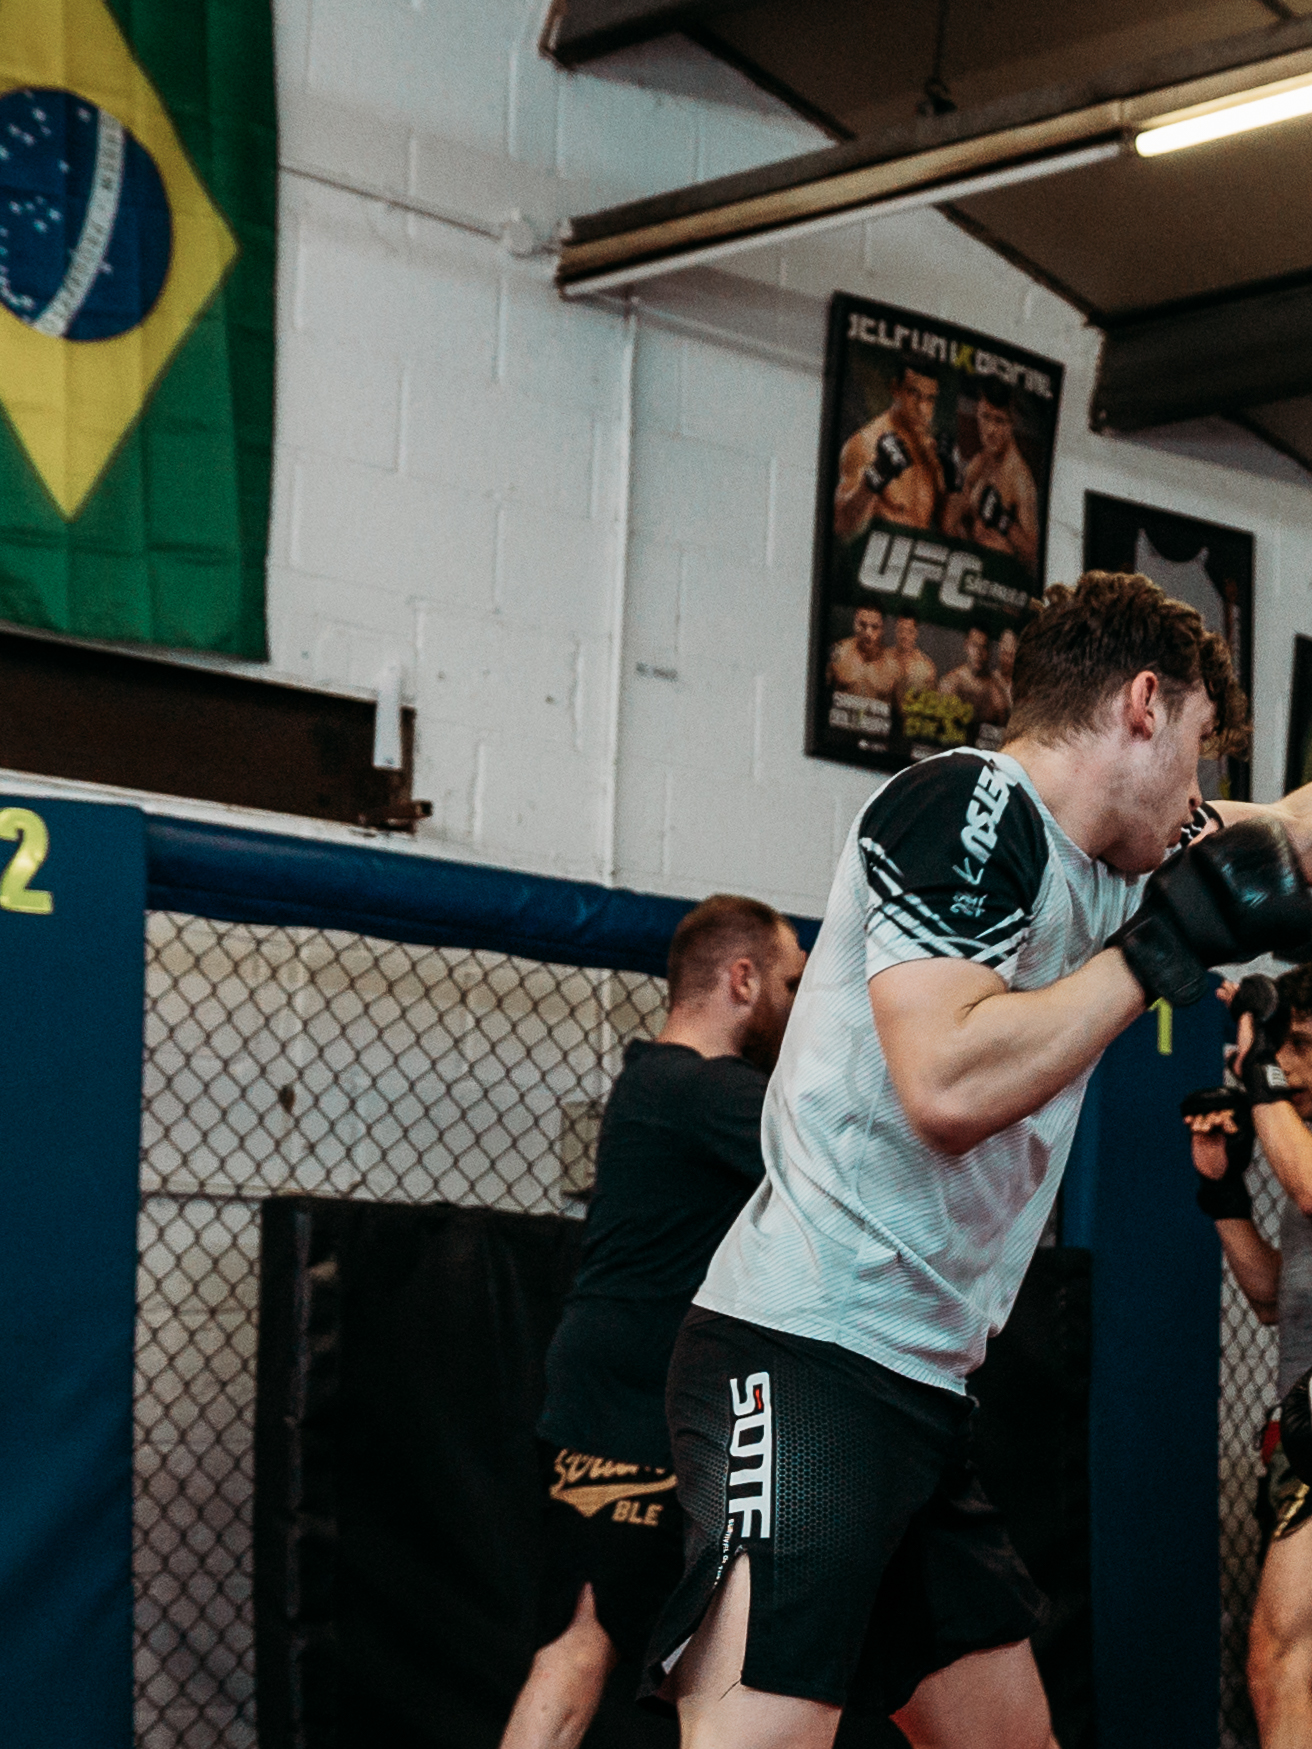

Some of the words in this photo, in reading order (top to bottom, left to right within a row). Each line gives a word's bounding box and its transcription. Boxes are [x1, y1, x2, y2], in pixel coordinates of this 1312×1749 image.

[858, 530, 983, 611] UFC
[0, 806, 54, 916] 2
[1148, 996, 1173, 1056] 1
[729, 1371, 773, 1538] SOTF
